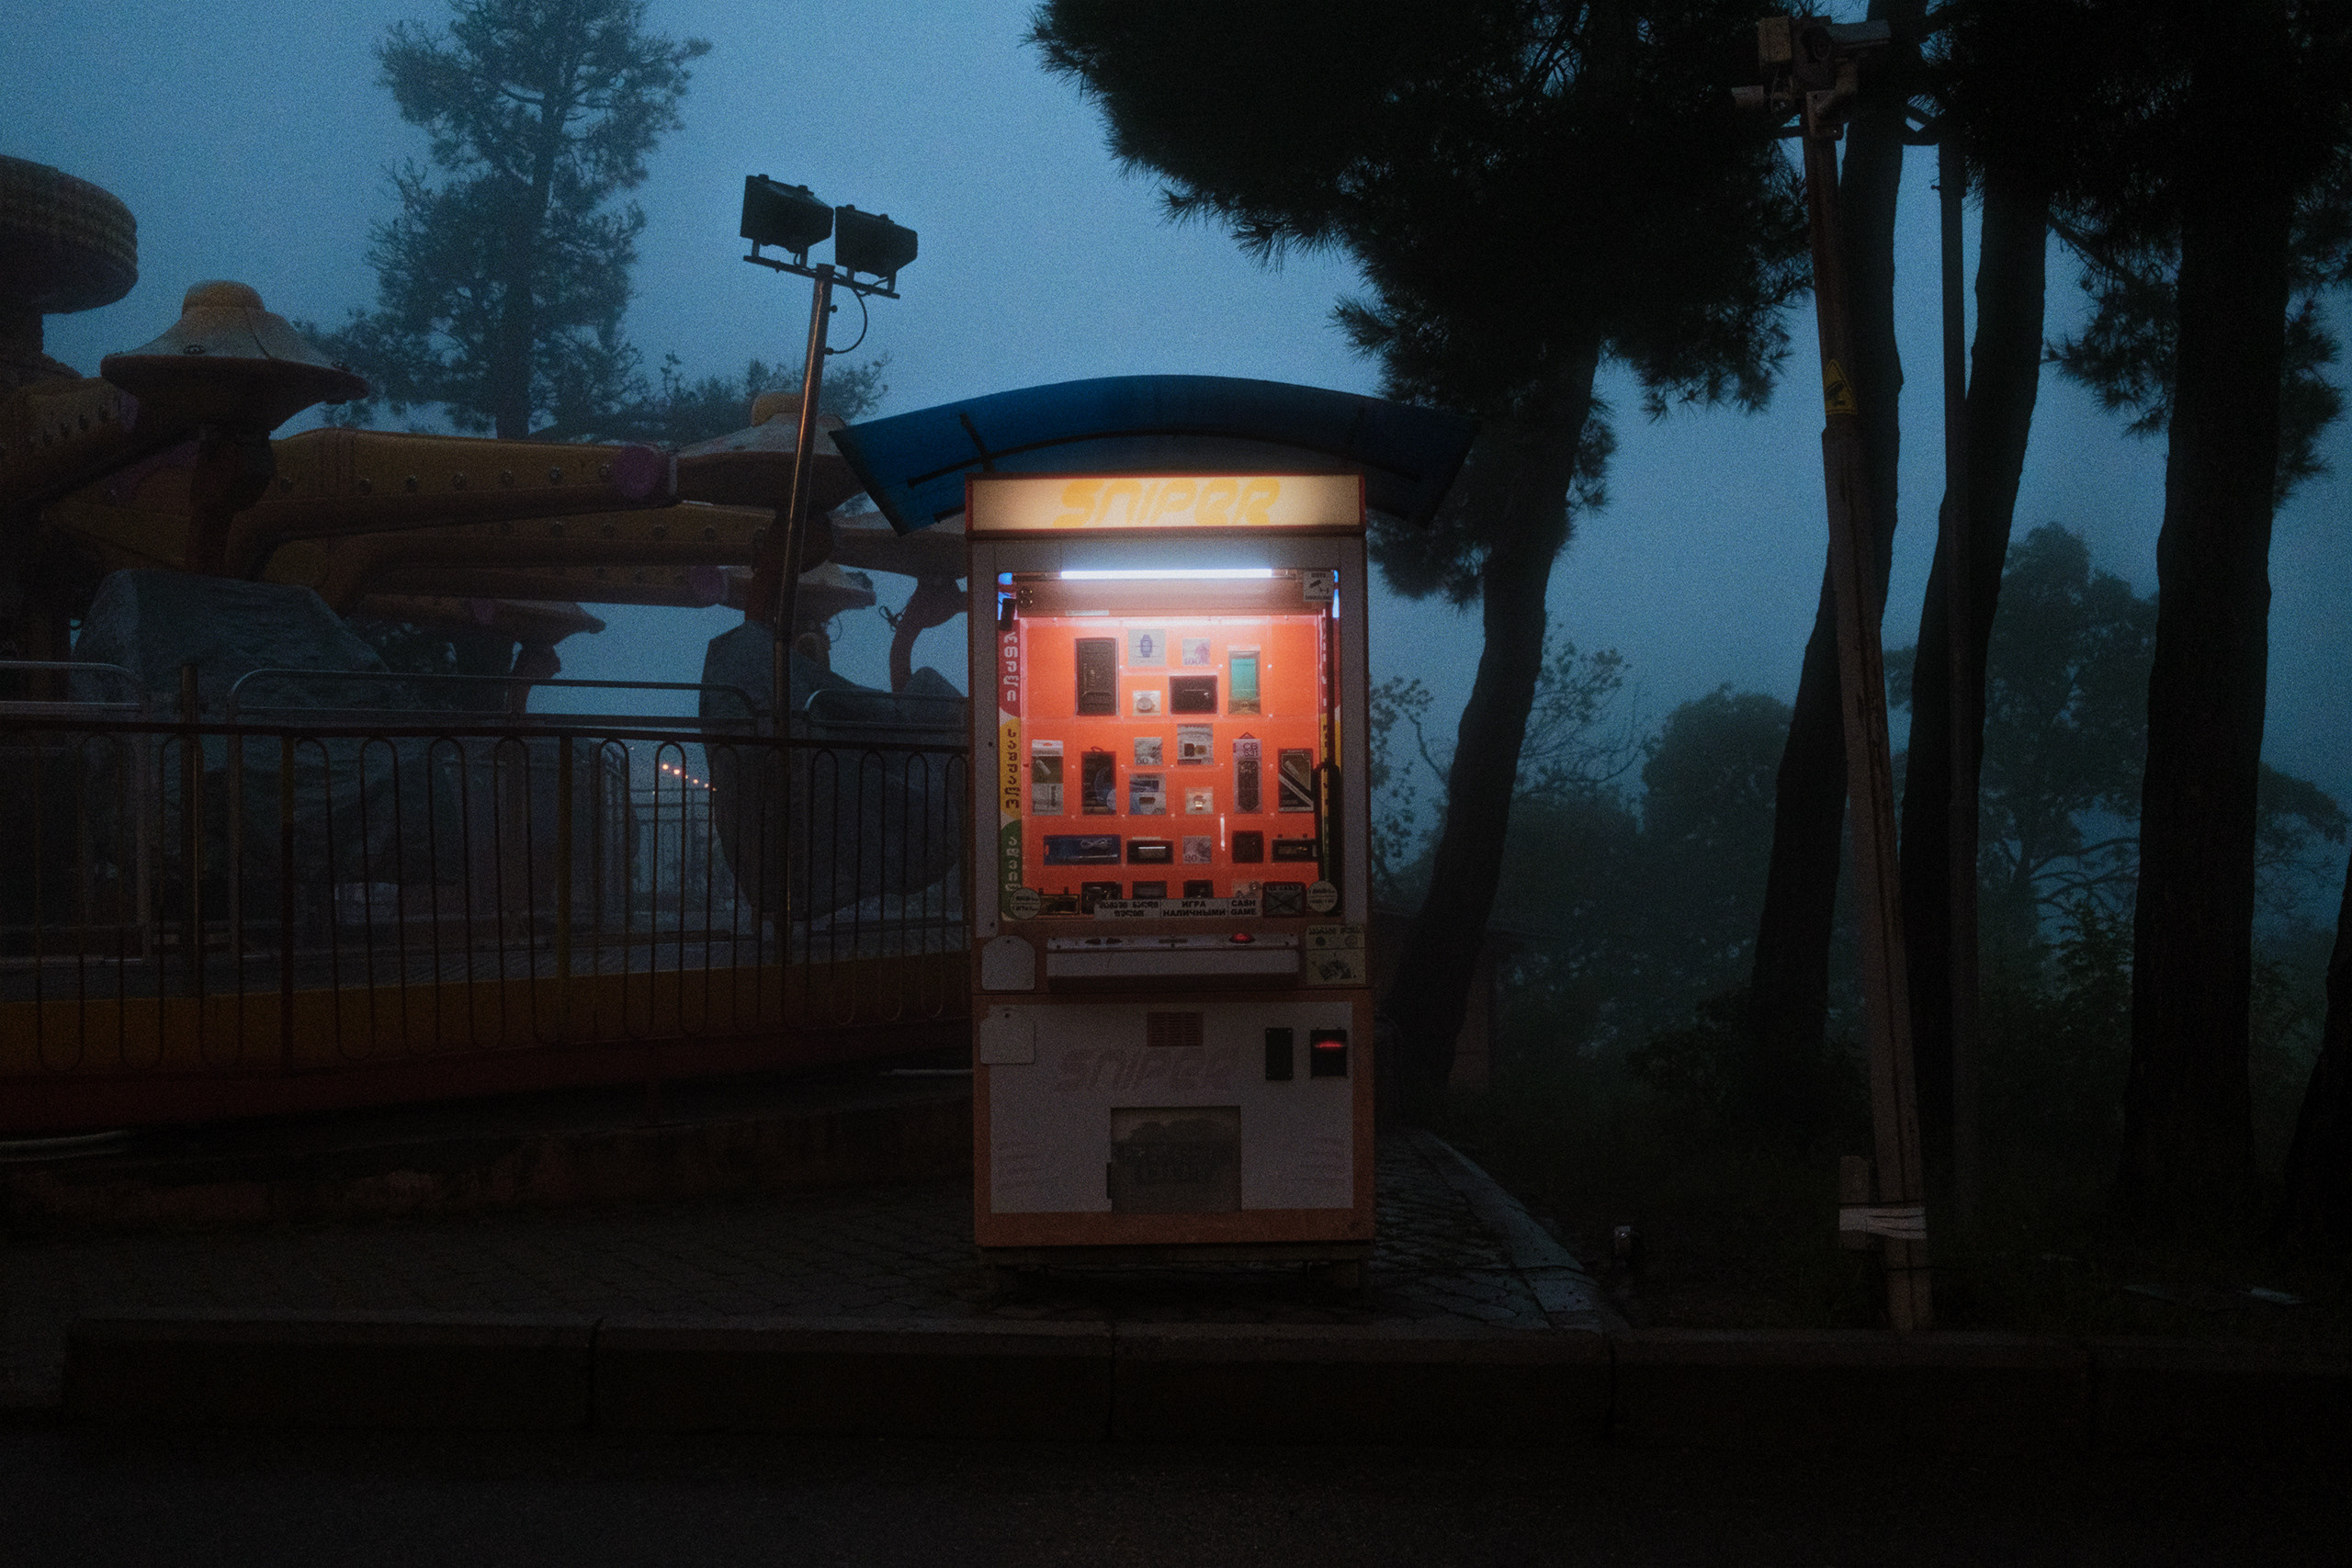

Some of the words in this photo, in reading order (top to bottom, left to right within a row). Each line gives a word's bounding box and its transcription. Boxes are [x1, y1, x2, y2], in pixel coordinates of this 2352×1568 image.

[1051, 478, 1281, 528] SNIPER
[1004, 728, 1021, 809] საშუალო
[1004, 836, 1022, 893] ადვილ
[1162, 908, 1226, 917] НАЛИЧНЫМИ
[1230, 908, 1257, 916] GAME
